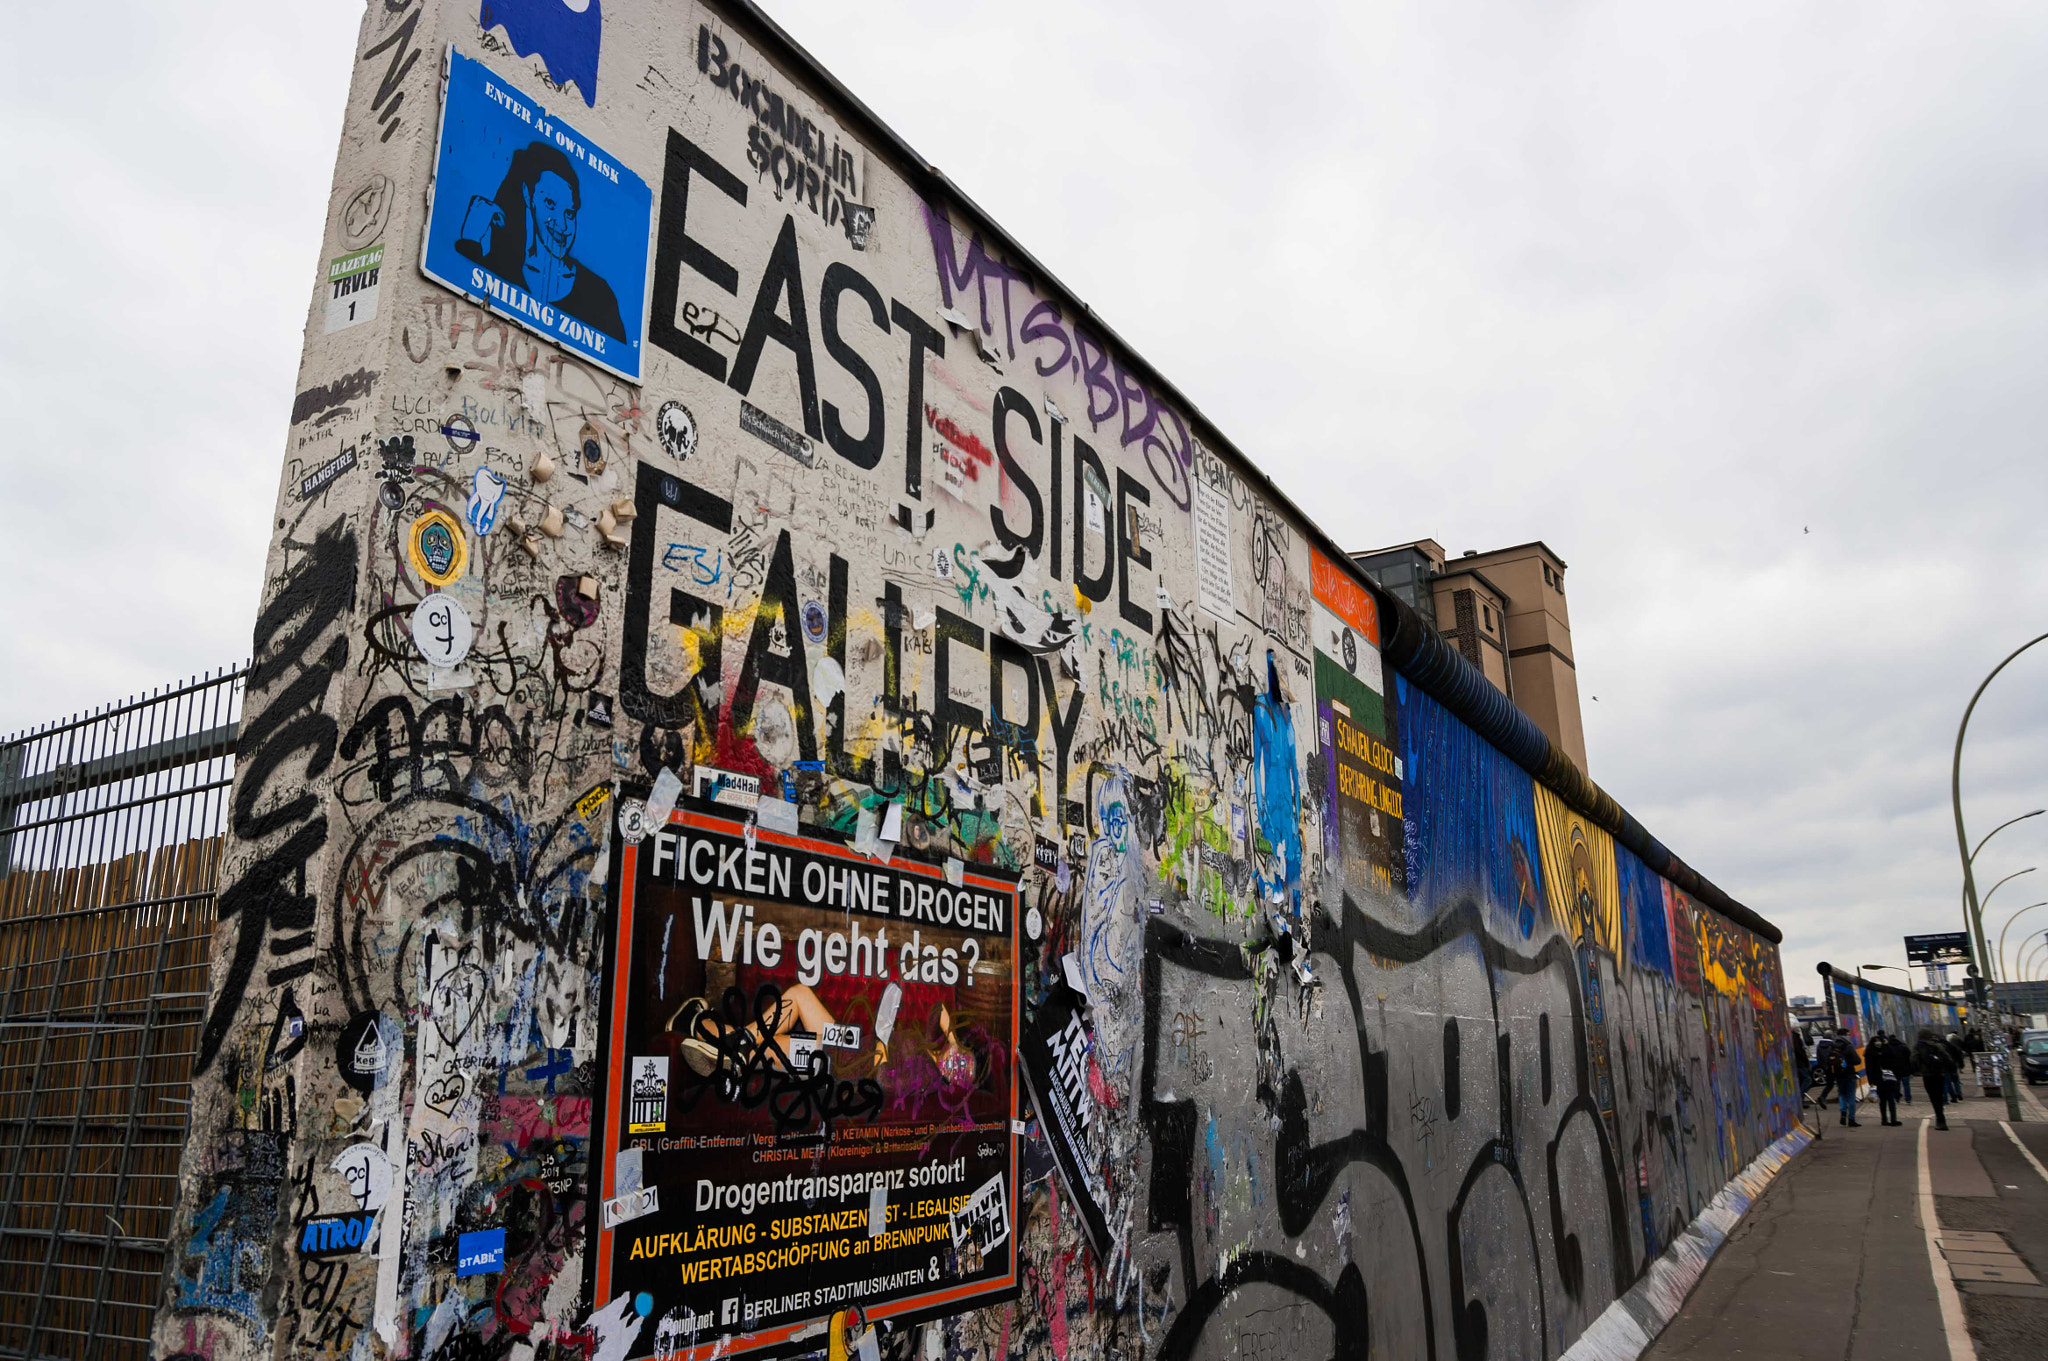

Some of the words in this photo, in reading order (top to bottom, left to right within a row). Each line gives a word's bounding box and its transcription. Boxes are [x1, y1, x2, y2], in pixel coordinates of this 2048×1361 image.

[484, 81, 532, 124] ENTER
[534, 117, 553, 138] AT
[555, 131, 586, 160] OWN
[588, 152, 619, 185] RISK
[333, 267, 379, 300] TRVLR
[348, 300, 356, 322] 1
[471, 267, 554, 327] SMILING
[558, 314, 606, 355] ZONE
[648, 125, 945, 502] EAST
[304, 450, 353, 494] HANGFIRE
[990, 386, 1153, 636] SIDE
[652, 831, 791, 898] FICKEN
[802, 861, 890, 915] OHNE
[899, 879, 1003, 933] DROGEN
[691, 896, 783, 969] Wie
[798, 920, 890, 988] geht
[900, 929, 981, 988] das?
[657, 1134, 745, 1155] (Graffiti-Entferner
[843, 1127, 880, 1141] KETAMIN
[914, 1125, 927, 1136] und
[752, 1149, 799, 1163] CHRISTAL
[827, 1143, 874, 1160] (Kloreiniger
[695, 1168, 905, 1215] Drogentransparenz
[908, 1156, 966, 1188] sofort!
[629, 1222, 756, 1261] AUFKLÄRUNG
[770, 1203, 900, 1241] SUBSTANZENST
[909, 1193, 971, 1220] LEGALISIE
[681, 1238, 850, 1285] WERTABSCHÖPFUNG
[853, 1238, 870, 1256] an
[744, 1290, 811, 1321] BERLINER
[814, 1268, 924, 1308] STADTMUSIKANTEN
[928, 1255, 940, 1282] &
